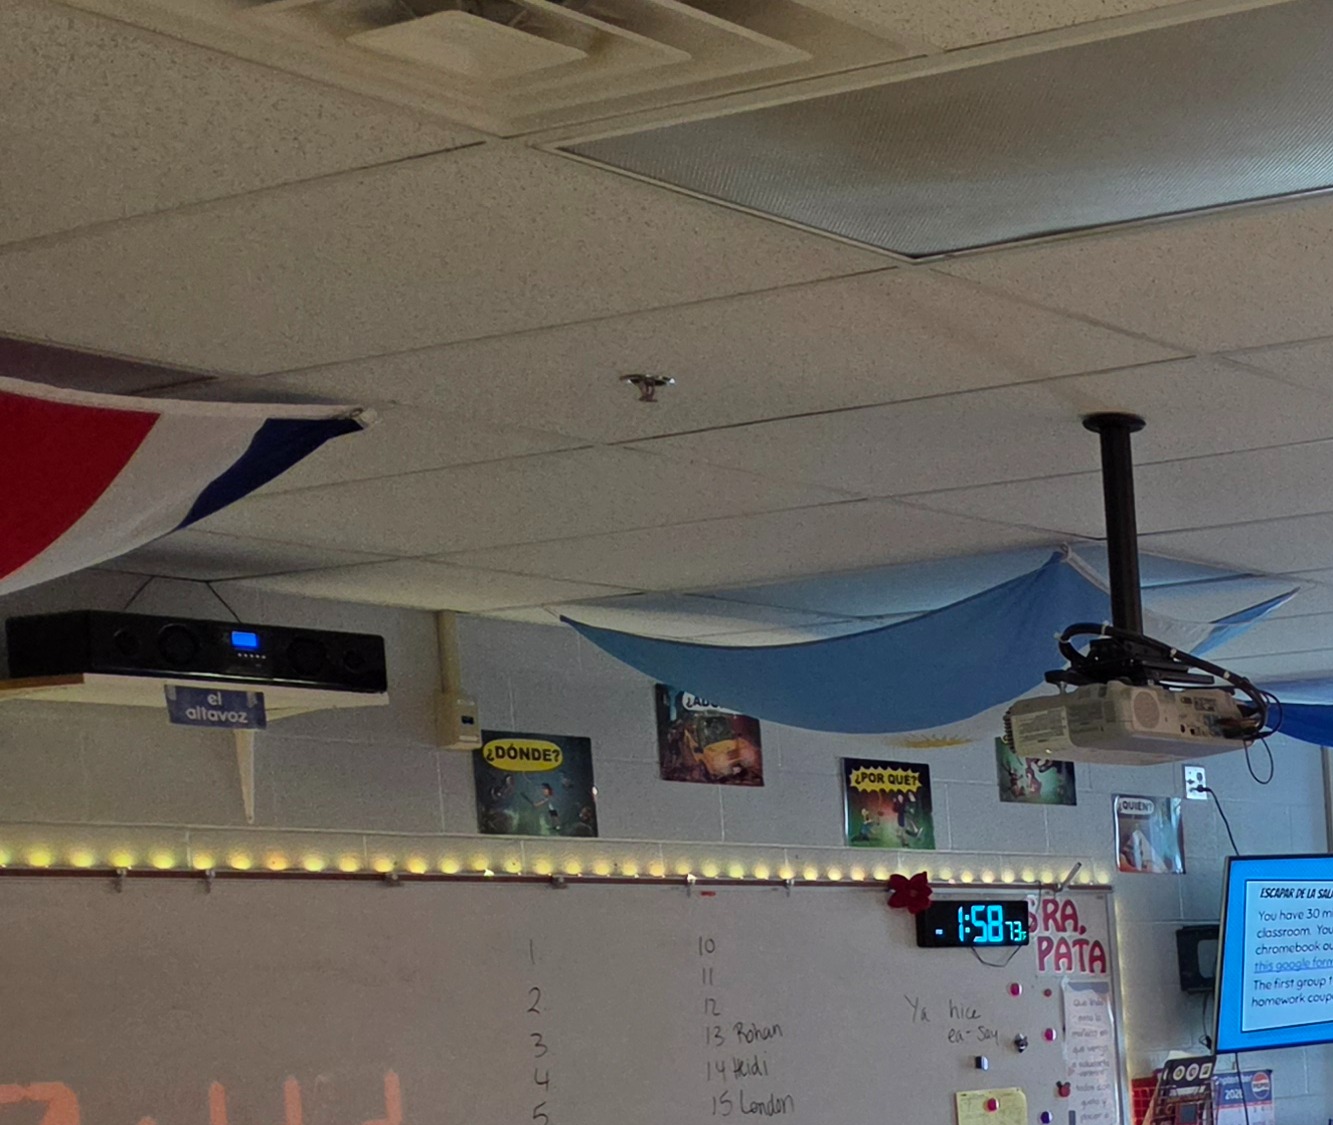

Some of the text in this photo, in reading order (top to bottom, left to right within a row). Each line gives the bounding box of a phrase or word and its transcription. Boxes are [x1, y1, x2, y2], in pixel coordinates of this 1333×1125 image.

[207, 691, 222, 706] el
[186, 705, 248, 724] altavoz
[485, 744, 562, 763] ¿DÓNDE?
[854, 772, 885, 787] ¿POR
[1260, 887, 1295, 898] ESCAPAR
[1295, 888, 1306, 898] DE
[1307, 888, 1315, 898] LA
[958, 905, 1003, 942] 1:58
[1258, 910, 1277, 921] You
[1280, 910, 1304, 920] have
[1306, 908, 1320, 919] 30
[1257, 927, 1311, 938] classroom.
[1317, 925, 1333, 935] You
[699, 936, 715, 956] 10
[1037, 936, 1107, 973] PATA
[1255, 941, 1320, 955] chromebook
[1254, 960, 1273, 973] this
[1275, 958, 1311, 973] google
[1253, 980, 1272, 990] The
[1274, 978, 1294, 989] first
[1296, 977, 1326, 991] group
[705, 998, 721, 1016] 12
[905, 994, 981, 1022] Ya hice
[1251, 993, 1306, 1007] homework
[707, 1021, 783, 1047] 13 Rohan
[707, 1051, 768, 1082] 14 Heidi
[713, 1090, 733, 1116] 15
